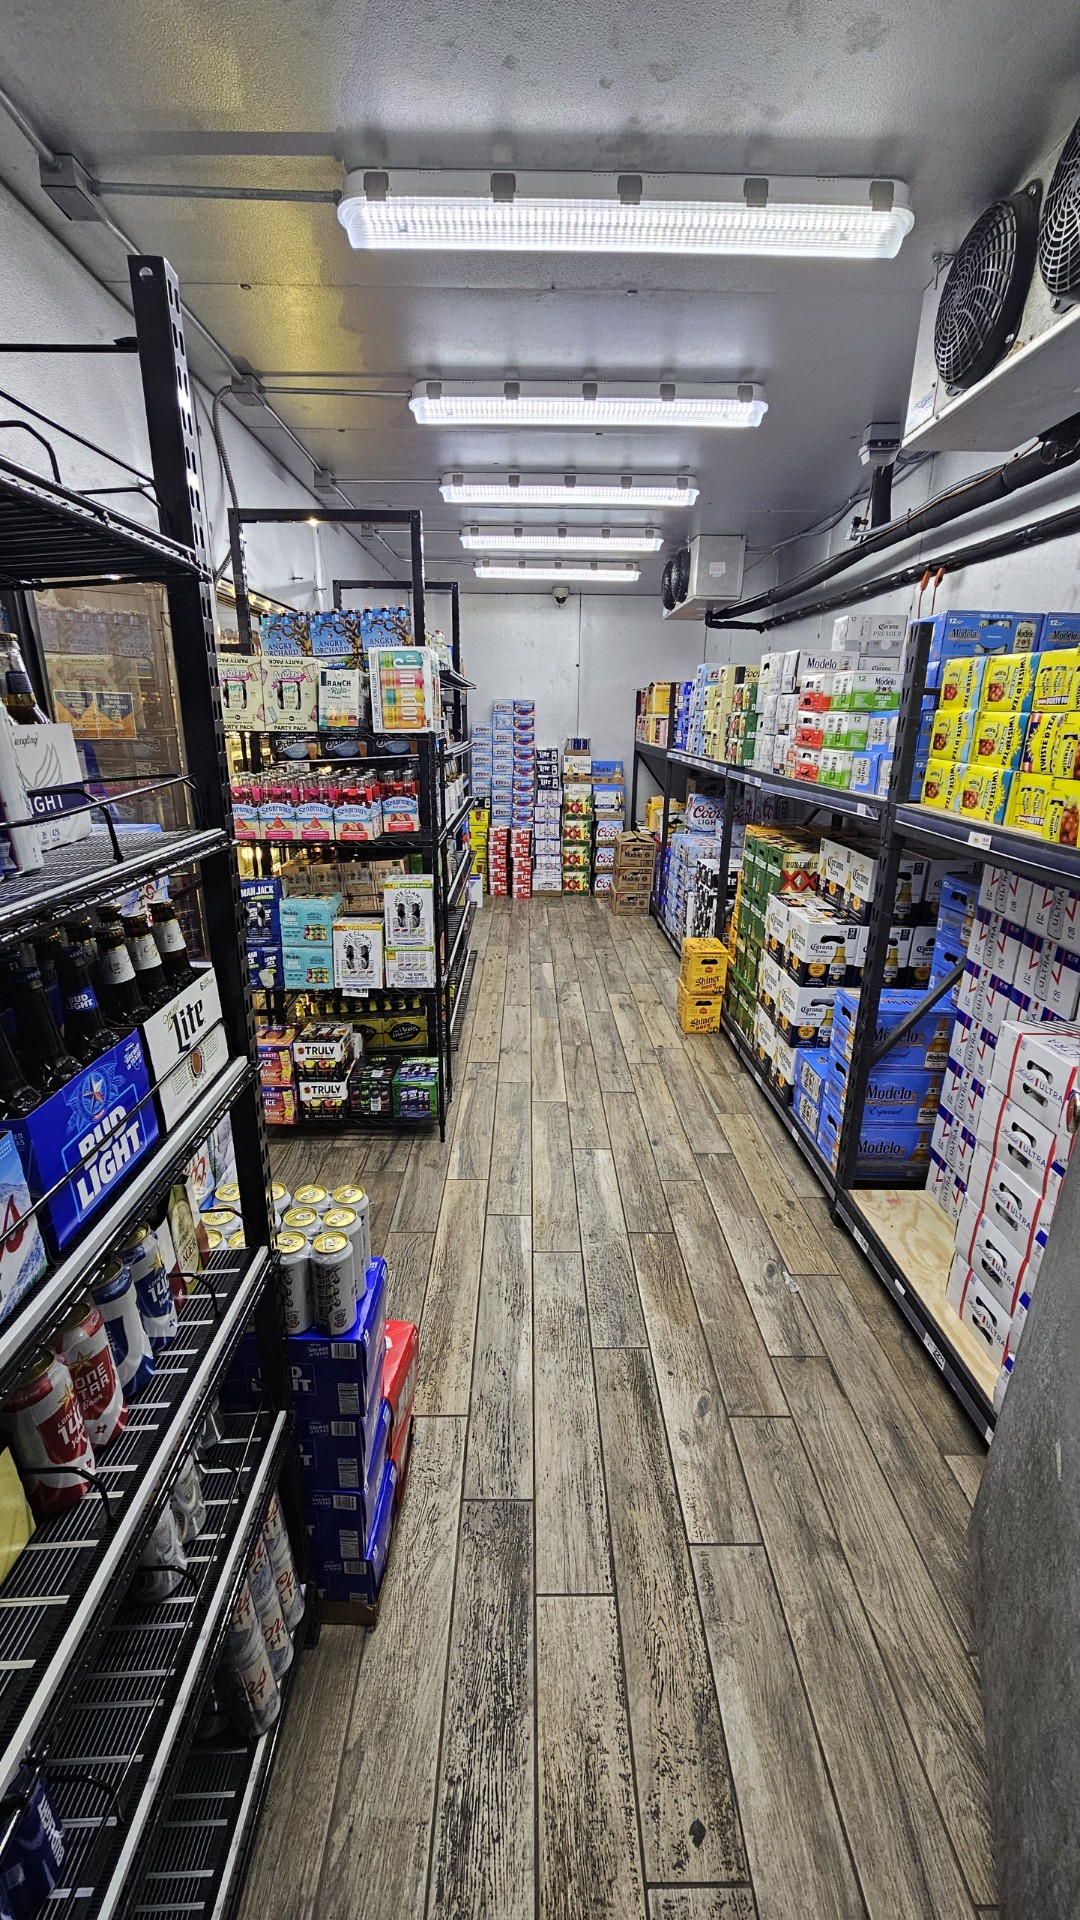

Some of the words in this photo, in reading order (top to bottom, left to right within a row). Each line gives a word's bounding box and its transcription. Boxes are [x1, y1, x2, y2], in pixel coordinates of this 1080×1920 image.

[952, 628, 977, 638] Modelo
[314, 646, 350, 654] ORCHARD
[807, 658, 837, 669] Modelo
[965, 659, 976, 692] TWISTED
[1016, 656, 1027, 694] TWISTED
[875, 677, 896, 685] Modelo
[1011, 696, 1020, 710] TEA
[955, 712, 964, 745] TWISTED
[1005, 714, 1016, 751] TWISTED
[1040, 733, 1050, 772] TWISTED
[1046, 715, 1057, 732] TEA
[1001, 752, 1010, 765] TEA
[947, 764, 956, 796] TWISTED
[988, 770, 999, 806] TWISTED
[984, 807, 992, 821] TEA
[828, 856, 844, 872] Corona
[853, 868, 869, 885] Corona
[998, 869, 1010, 900] ULTRA
[256, 885, 274, 895] JACK
[1052, 890, 1065, 926] ULTRA
[792, 928, 806, 946] Corona
[810, 943, 833, 951] Corona
[987, 925, 997, 956] ULTRA
[696, 975, 721, 986] Shiner
[1039, 954, 1050, 988] ULTRA
[66, 998, 94, 1010] LIGHT
[68, 994, 88, 1004] BUD
[976, 980, 986, 1010] ULTRA
[172, 999, 206, 1054] Lite
[690, 1014, 716, 1029] Shiner
[305, 1046, 335, 1055] TRULY
[968, 1032, 977, 1061] ULTRA
[311, 1086, 341, 1094] TRULY
[866, 1085, 912, 1099] Modelo
[958, 1082, 968, 1109] ULTRA
[1040, 1082, 1063, 1103] ULTRA
[78, 1105, 127, 1170] BUD
[859, 1140, 900, 1154] Modelo
[949, 1130, 958, 1156] ULTRA
[76, 1121, 139, 1210] LIGHT
[1023, 1146, 1046, 1167] ULTRA
[943, 1176, 953, 1203] ULTRA
[1011, 1206, 1030, 1230] ULTRA
[995, 1263, 1015, 1288] ULTRA
[986, 1321, 1005, 1346] ULTRA
[75, 1362, 105, 1390] ONE
[77, 1373, 110, 1399] TAR
[82, 1394, 103, 1411] Beer
